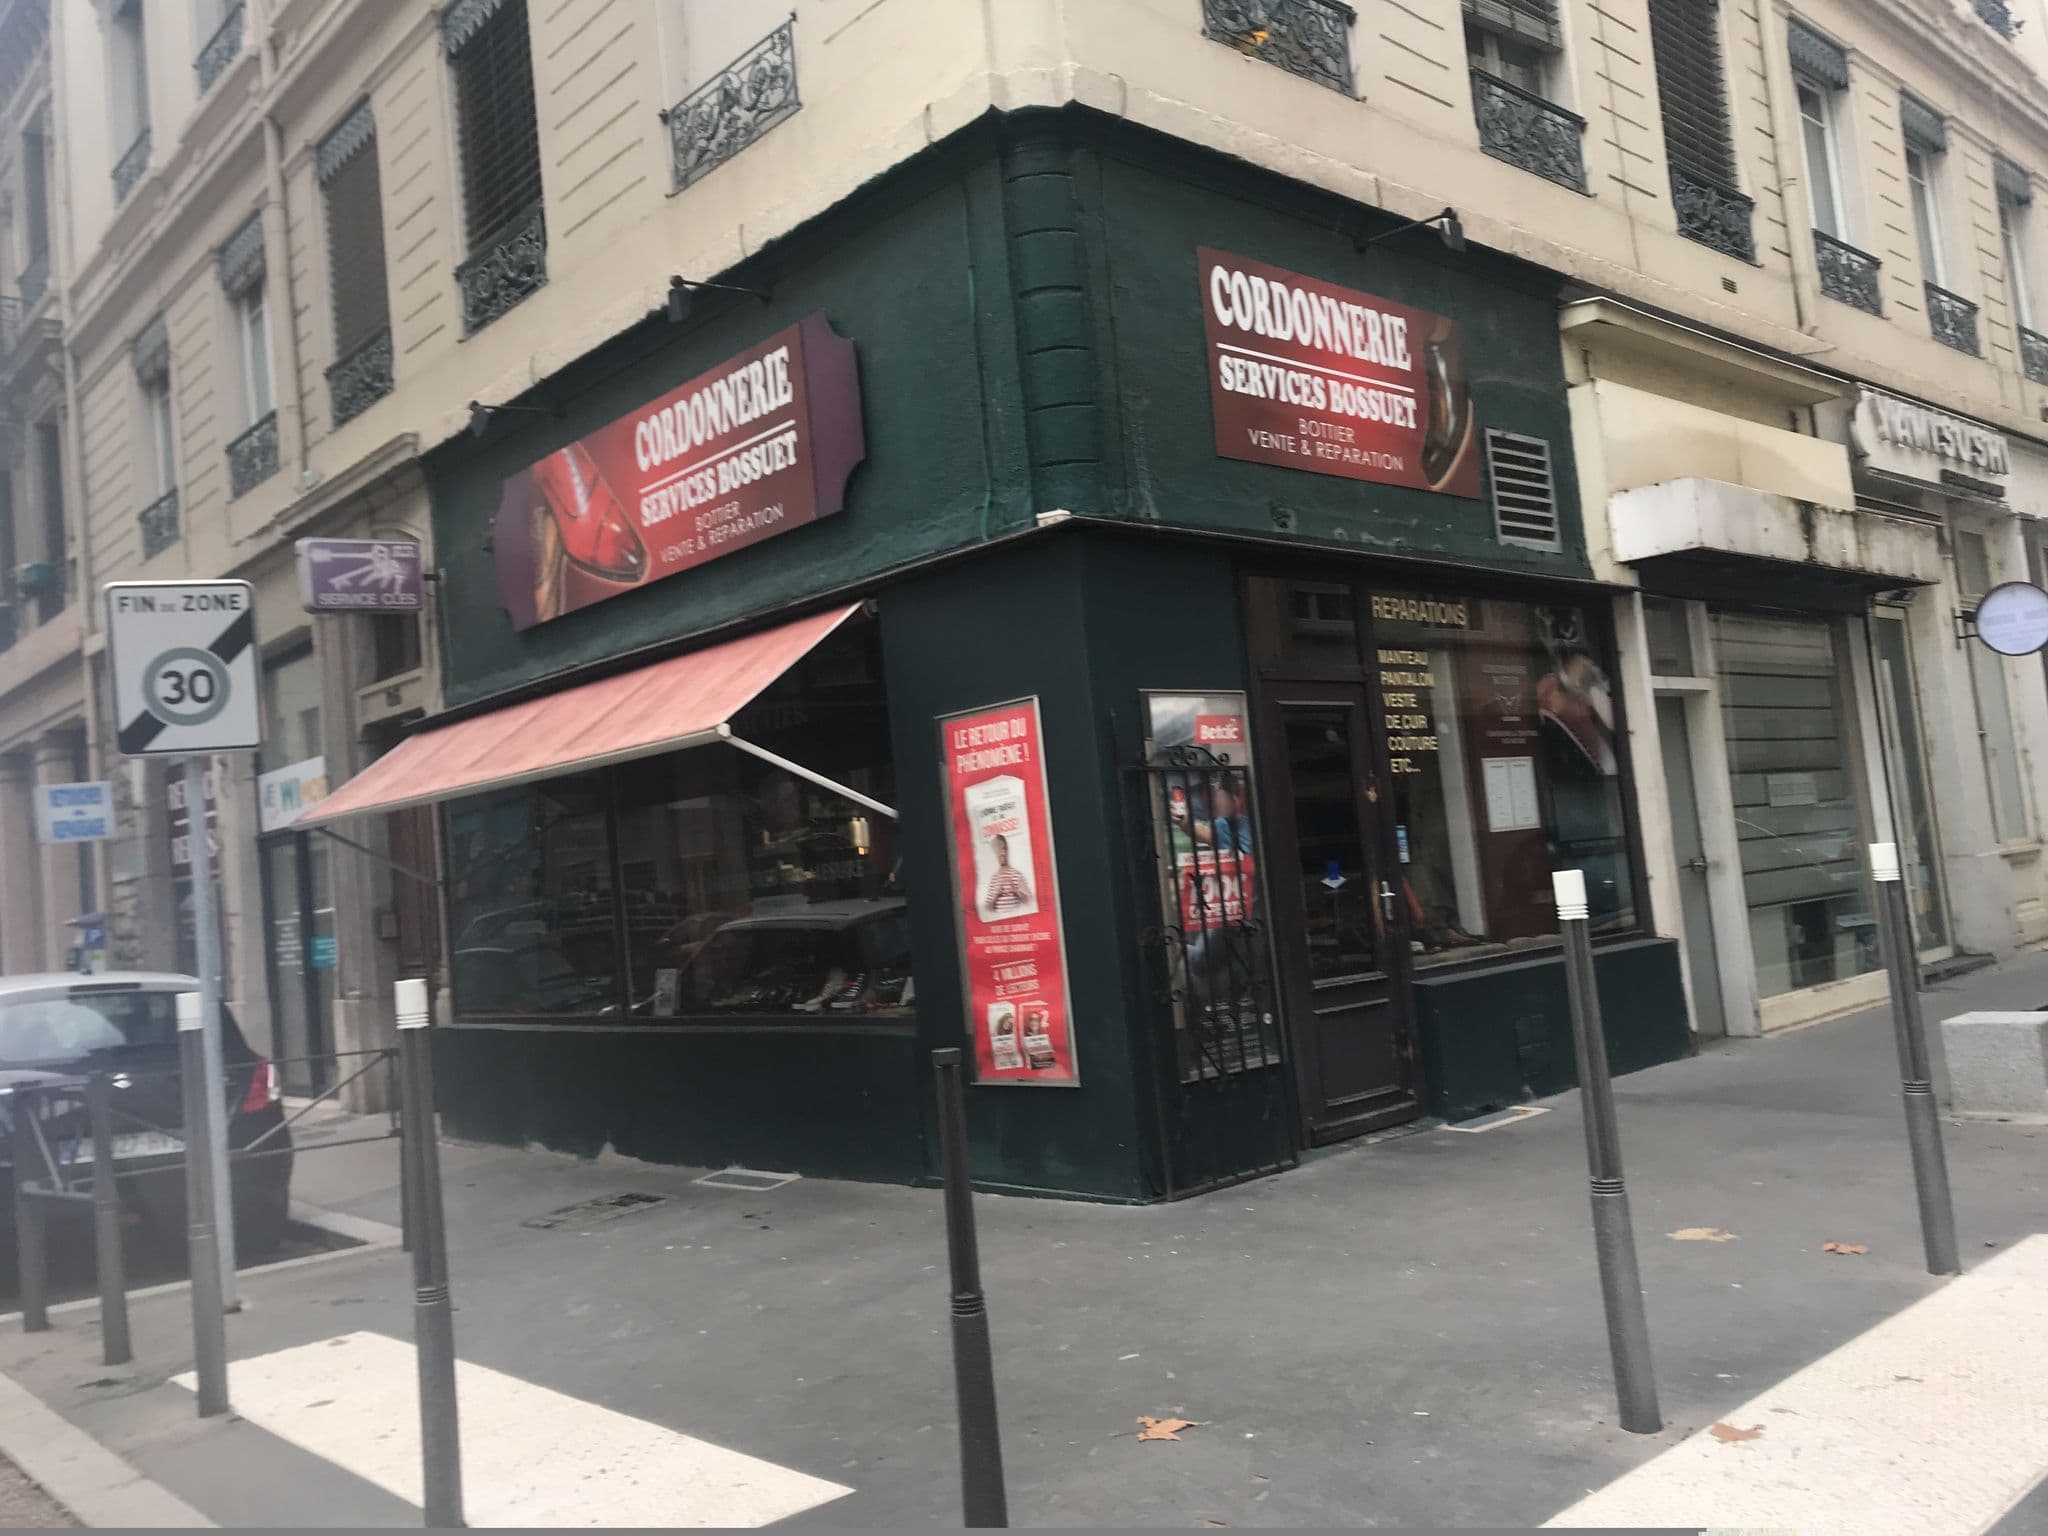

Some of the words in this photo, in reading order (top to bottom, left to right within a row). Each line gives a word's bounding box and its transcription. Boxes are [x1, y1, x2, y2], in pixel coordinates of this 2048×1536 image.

[1210, 265, 1412, 371] CORDONNERIE
[1219, 354, 1326, 411] SERVICES
[1329, 380, 1417, 429] BOSSUET
[635, 345, 793, 472] CORDONNERIE
[1247, 428, 1296, 453] VENTE
[1300, 439, 1312, 456] &
[1298, 418, 1355, 443] BOTTIER
[640, 467, 718, 527] SERVICES
[719, 430, 798, 494] BOSSUET
[695, 501, 741, 532] BOTTIER
[660, 538, 696, 564] VENTE
[697, 535, 707, 551] &
[118, 595, 155, 613] FIN
[180, 593, 241, 611] ZONE
[161, 668, 215, 705] 30
[1380, 671, 1435, 688] PANTALON
[1383, 693, 1418, 708] VESTE
[968, 721, 1009, 747] RETOUR
[1010, 717, 1028, 739] DU
[1402, 714, 1428, 729] CUIR
[1387, 736, 1438, 751] COUTURE
